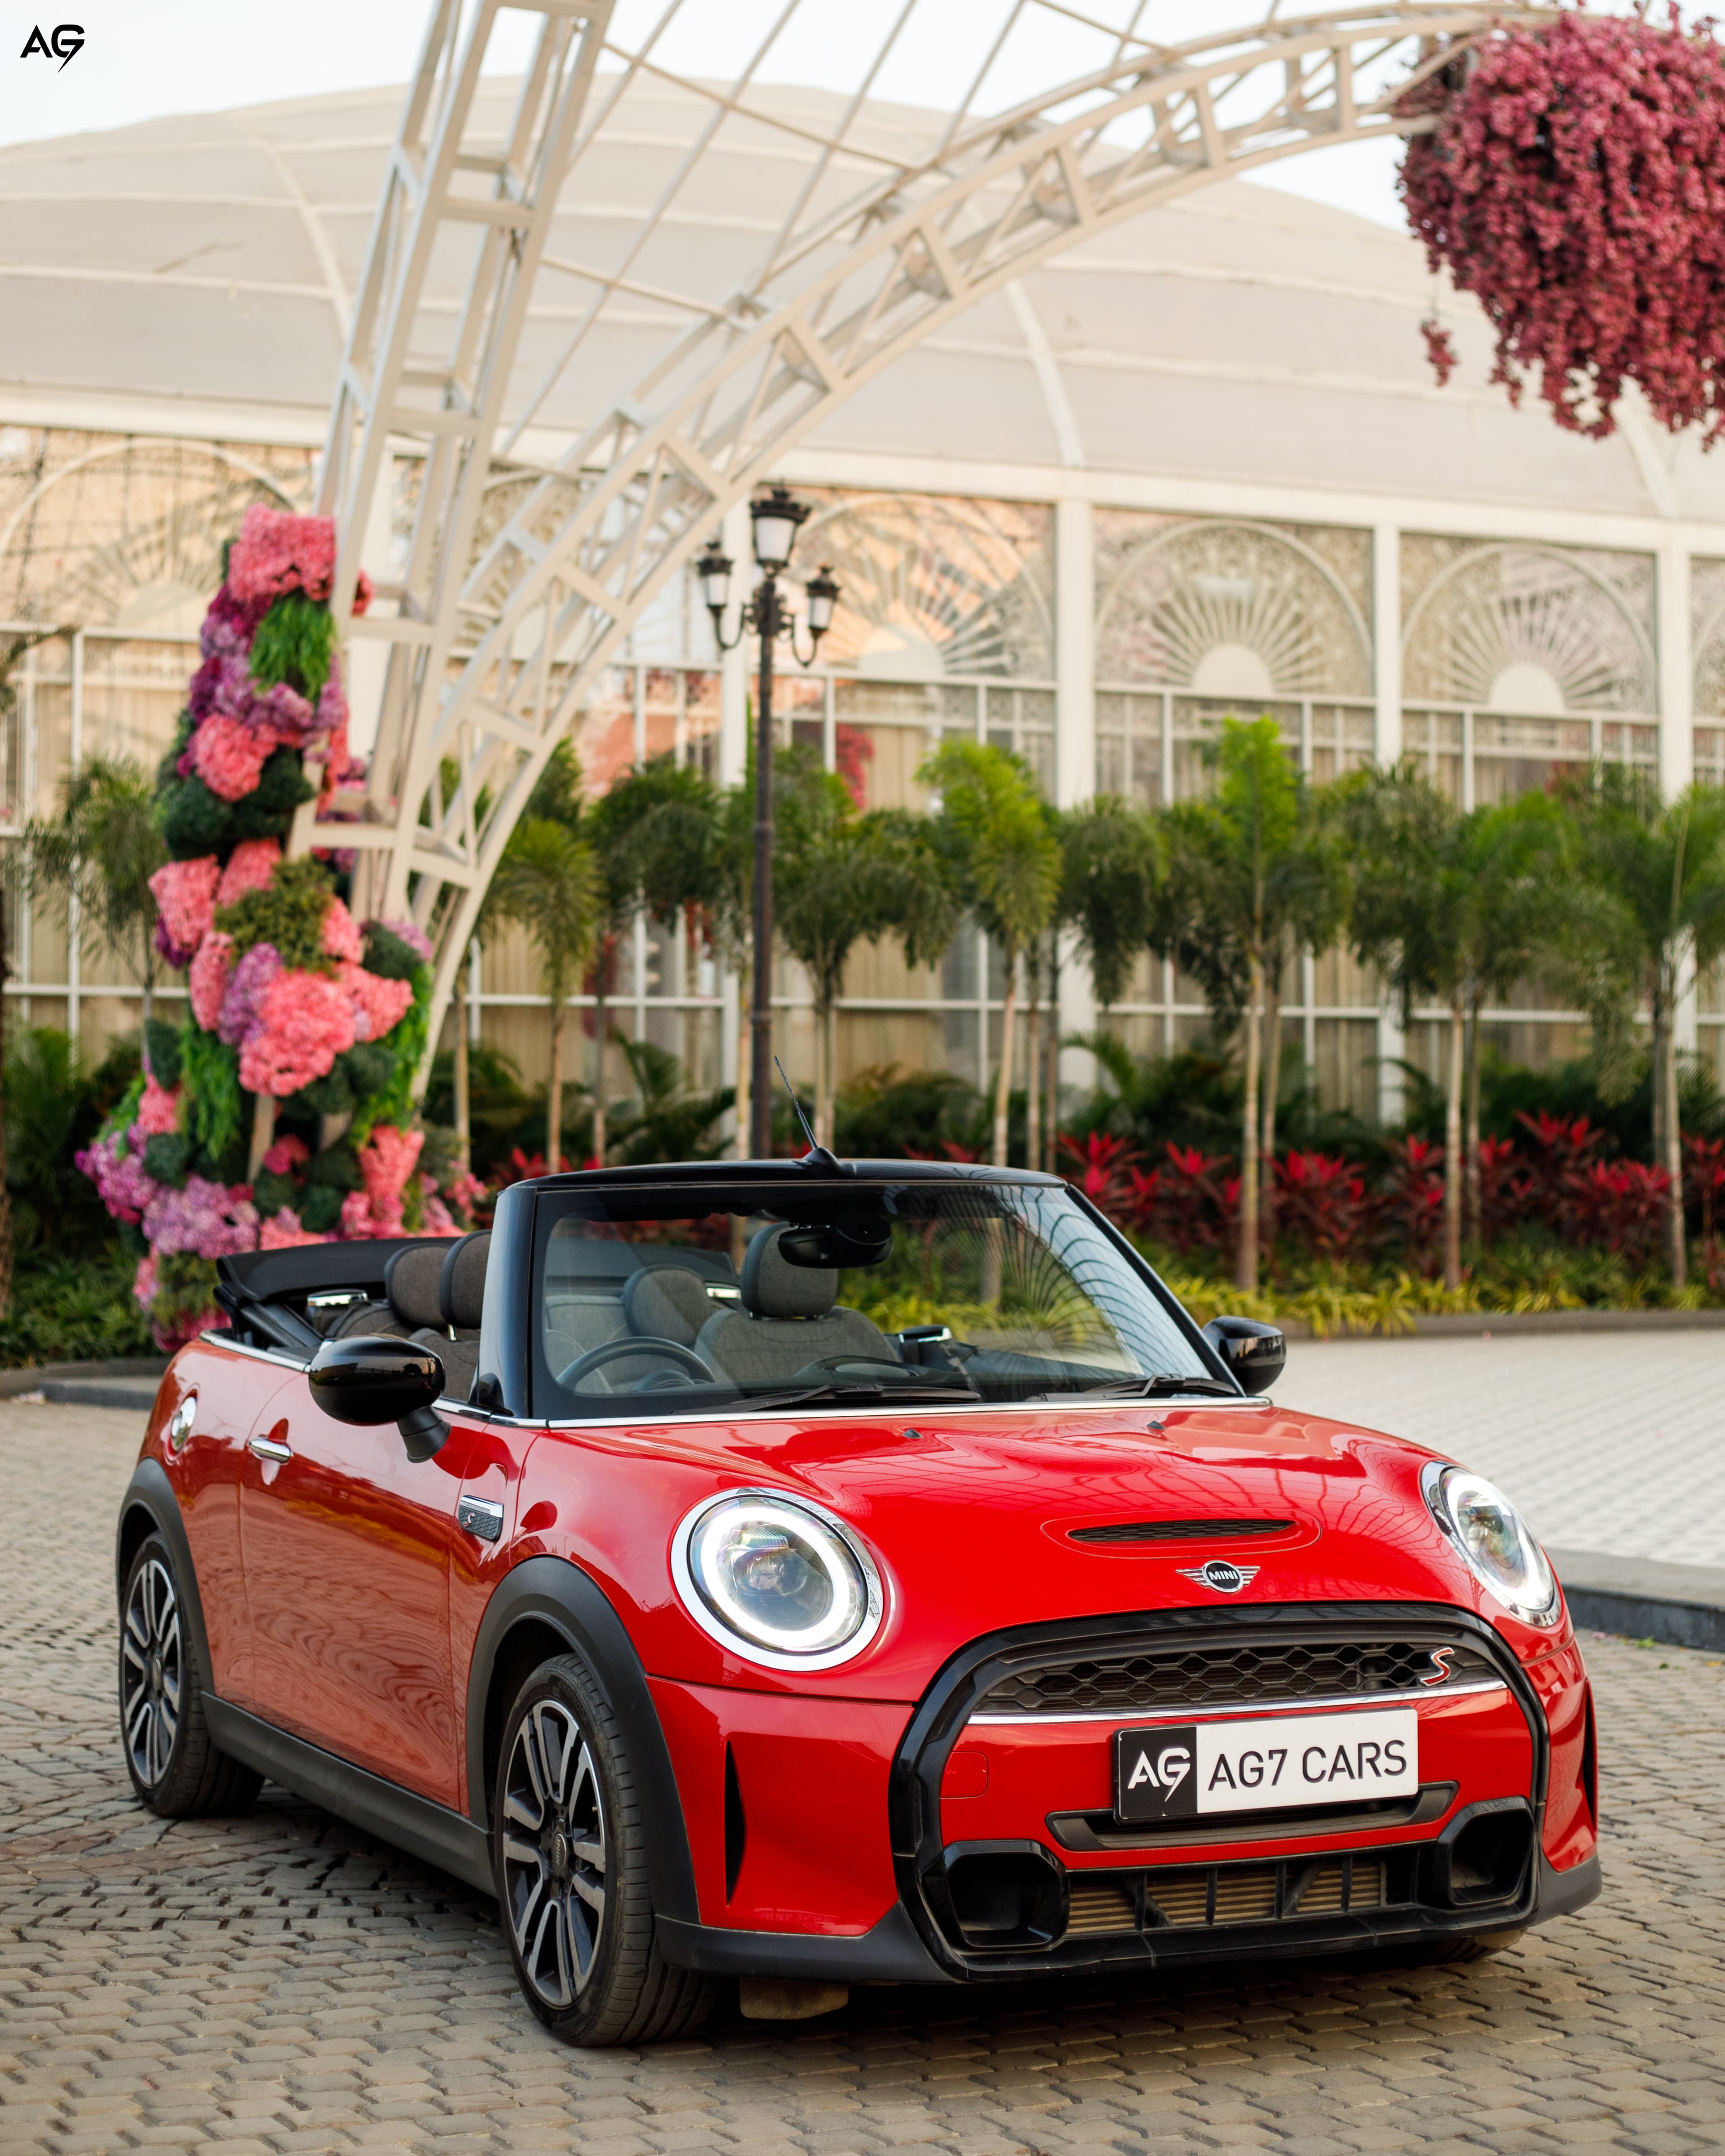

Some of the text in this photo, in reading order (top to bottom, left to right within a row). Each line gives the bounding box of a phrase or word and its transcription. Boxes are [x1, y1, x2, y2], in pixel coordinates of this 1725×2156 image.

[1208, 1571, 1238, 1580] MINI
[1420, 1647, 1455, 1686] S
[1208, 1740, 1407, 1791] AG7 CARS
